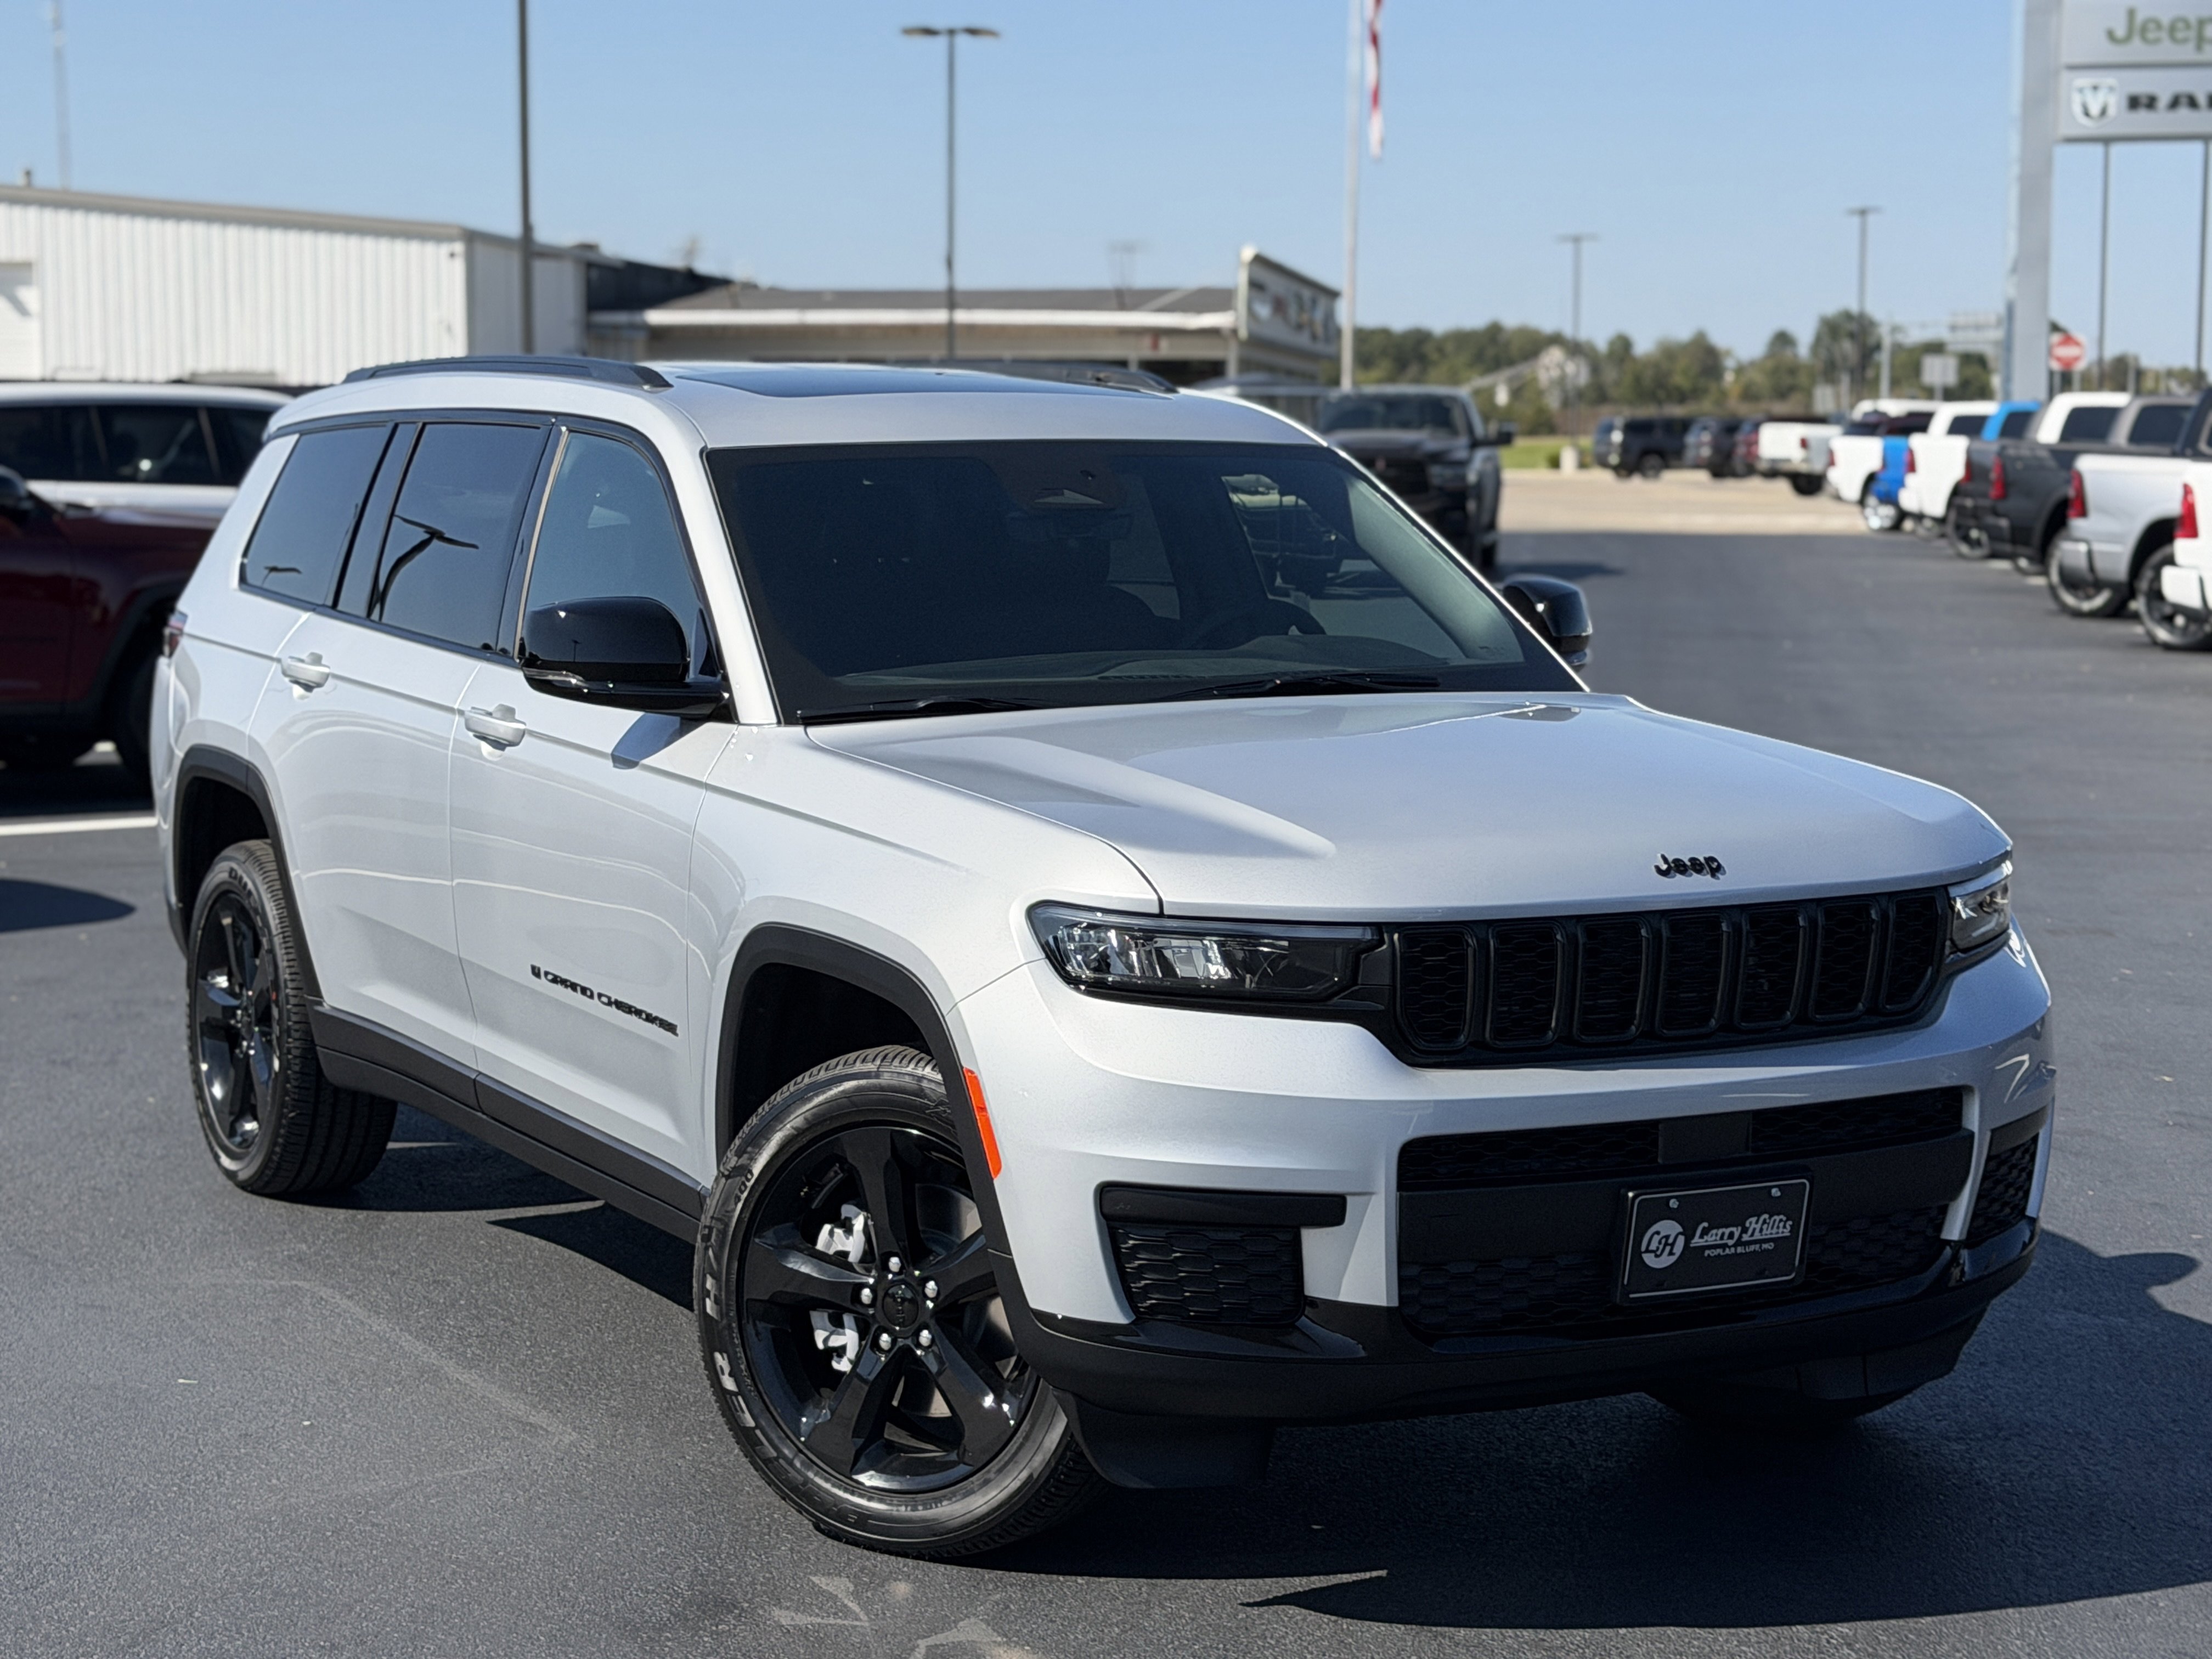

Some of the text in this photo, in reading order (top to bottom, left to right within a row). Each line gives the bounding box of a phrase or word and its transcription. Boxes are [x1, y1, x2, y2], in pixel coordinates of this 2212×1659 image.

[2127, 92, 2212, 111] RA
[1654, 854, 1722, 878] Jeep
[544, 970, 679, 1037] GRAND CHEROKEE
[735, 1169, 754, 1206] 400
[1690, 1214, 1793, 1246] Larry Hillis
[1704, 1247, 1735, 1257] POPLAR
